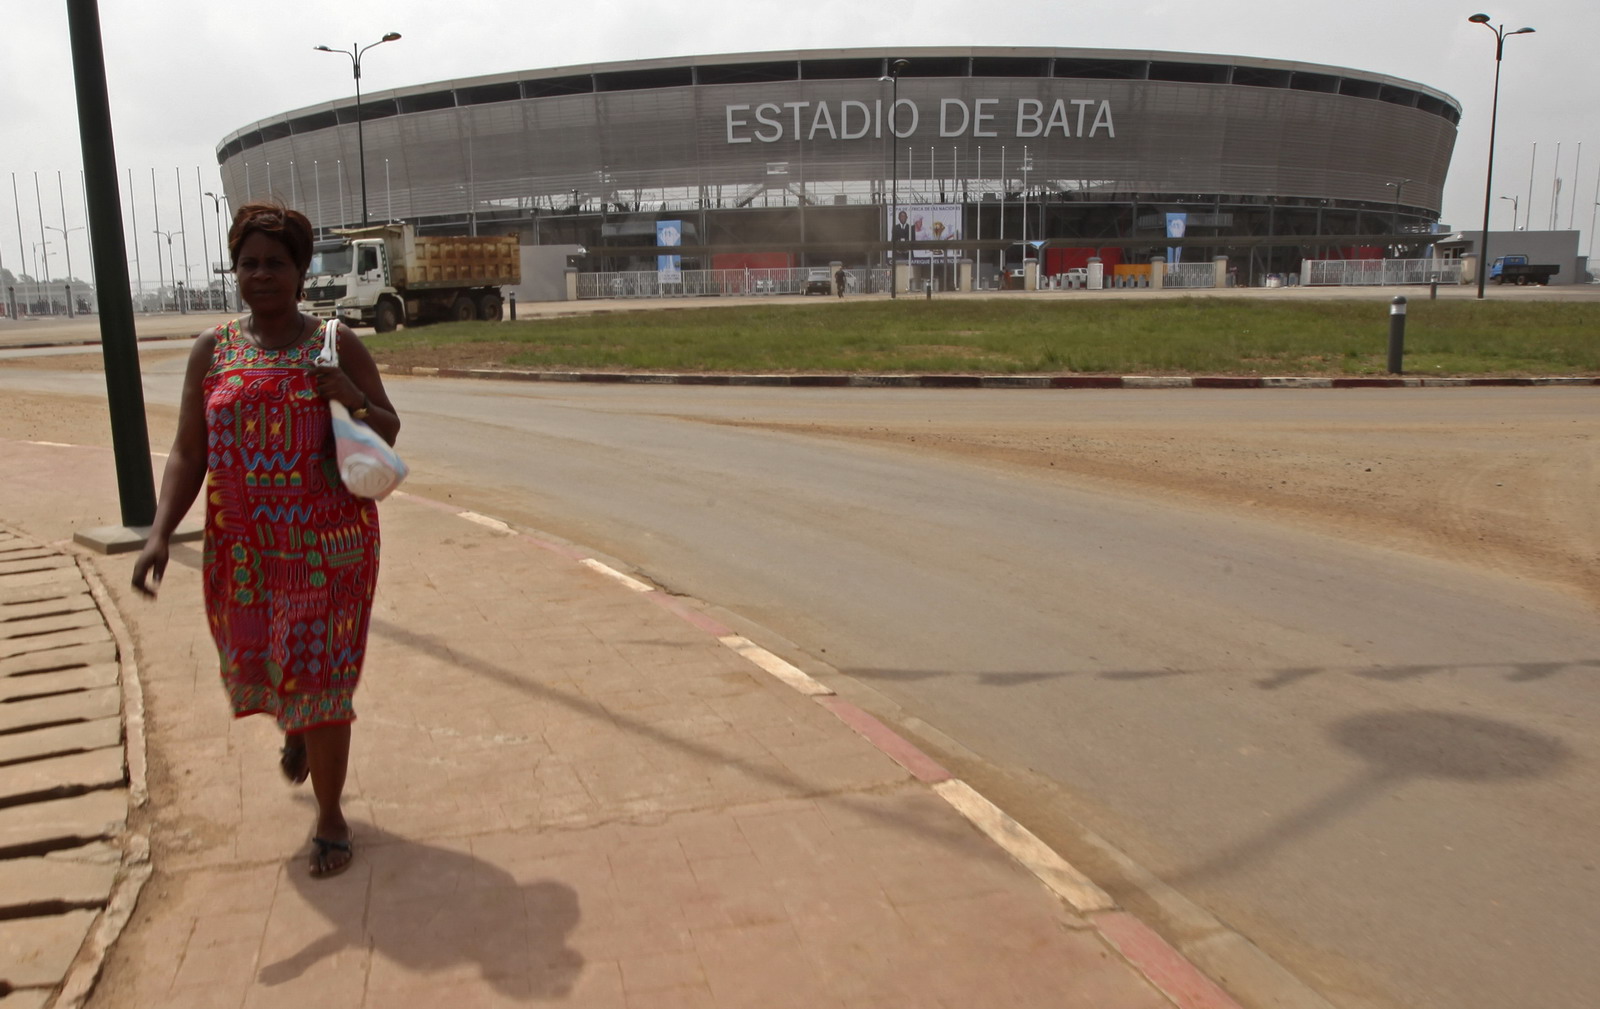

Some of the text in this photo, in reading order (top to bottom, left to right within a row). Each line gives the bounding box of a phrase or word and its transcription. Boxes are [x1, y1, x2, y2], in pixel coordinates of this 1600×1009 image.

[726, 98, 1116, 143] ESTADIO DE BATA
